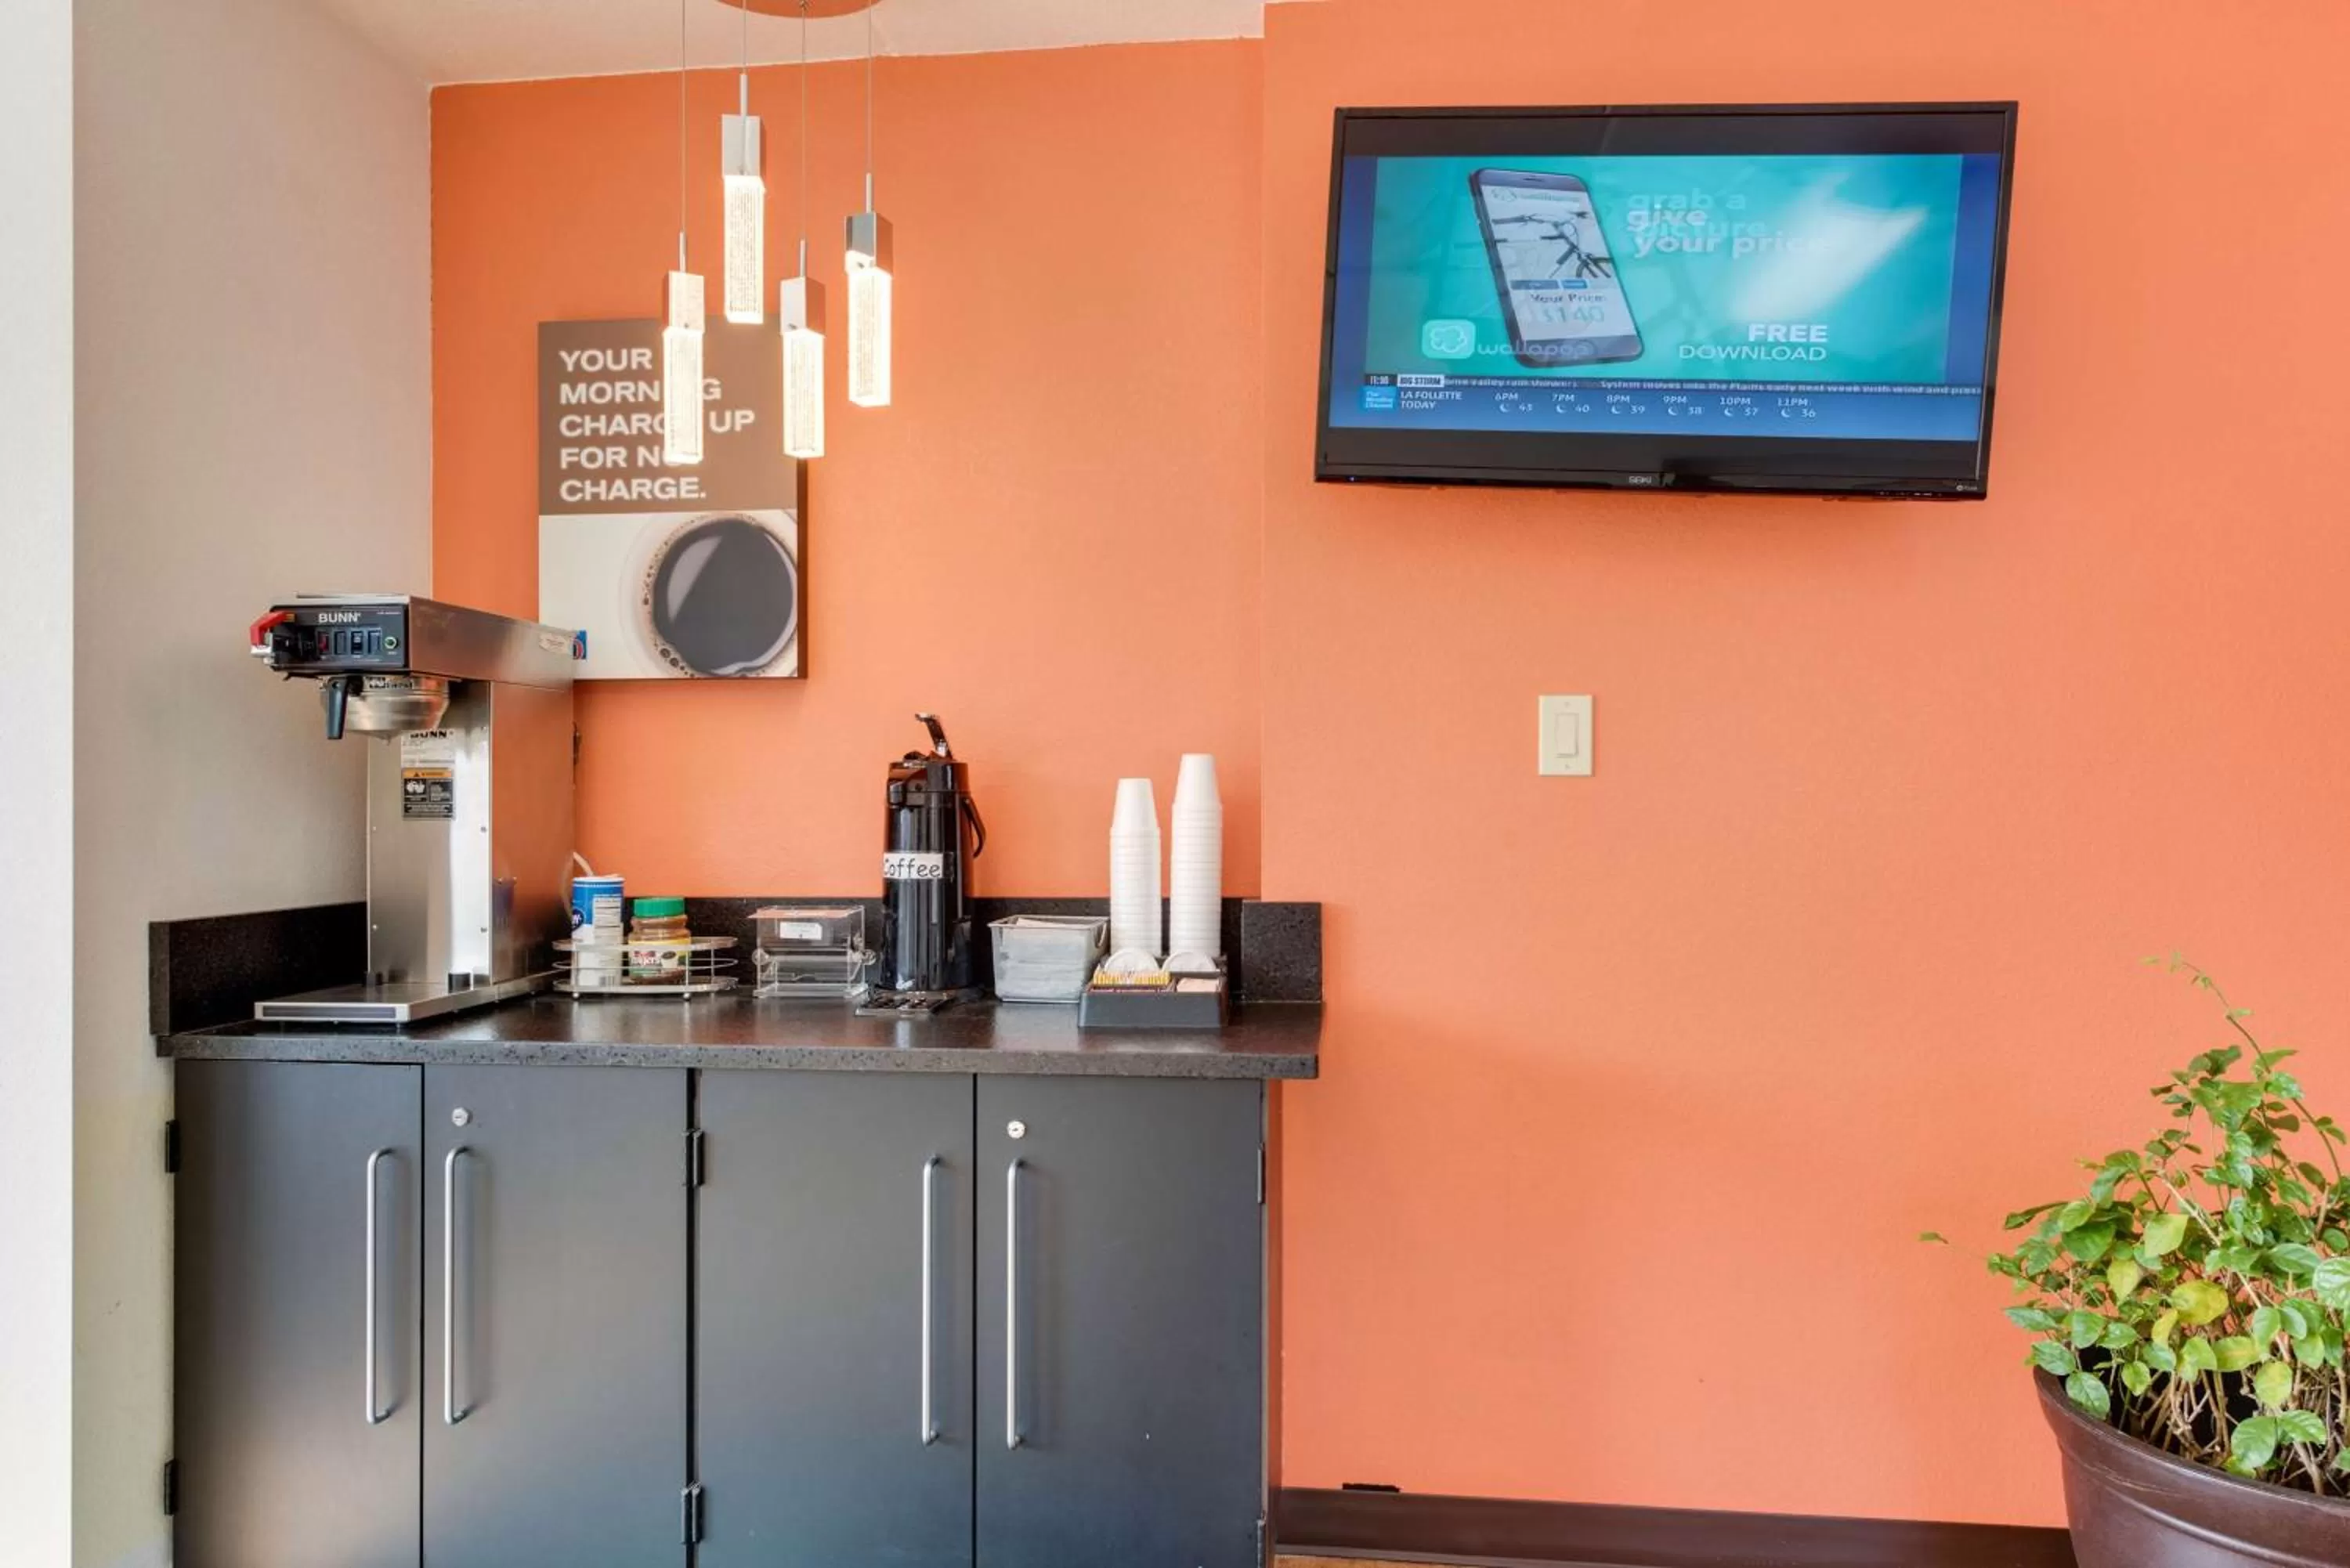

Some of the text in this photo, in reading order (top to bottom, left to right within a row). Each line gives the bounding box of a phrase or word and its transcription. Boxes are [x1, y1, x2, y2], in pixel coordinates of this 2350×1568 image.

[1627, 204, 1707, 232] give
[1634, 230, 1831, 259] your pric
[1748, 323, 1828, 342] FREE
[559, 348, 653, 372] YOUR
[1679, 345, 1827, 361] DOWNLOAD
[559, 378, 722, 405] MORNG
[1400, 391, 1462, 400] LA FOLLETTE
[1494, 393, 1519, 402] 6PM
[1777, 398, 1808, 406] 11PM
[1401, 400, 1436, 409] TODAY
[1630, 405, 1646, 414] 39
[1802, 409, 1817, 417] 36
[559, 410, 755, 437] CHAR UP
[561, 446, 627, 469] FOR
[559, 477, 706, 501] CHARGE.
[318, 612, 358, 623] BUNN
